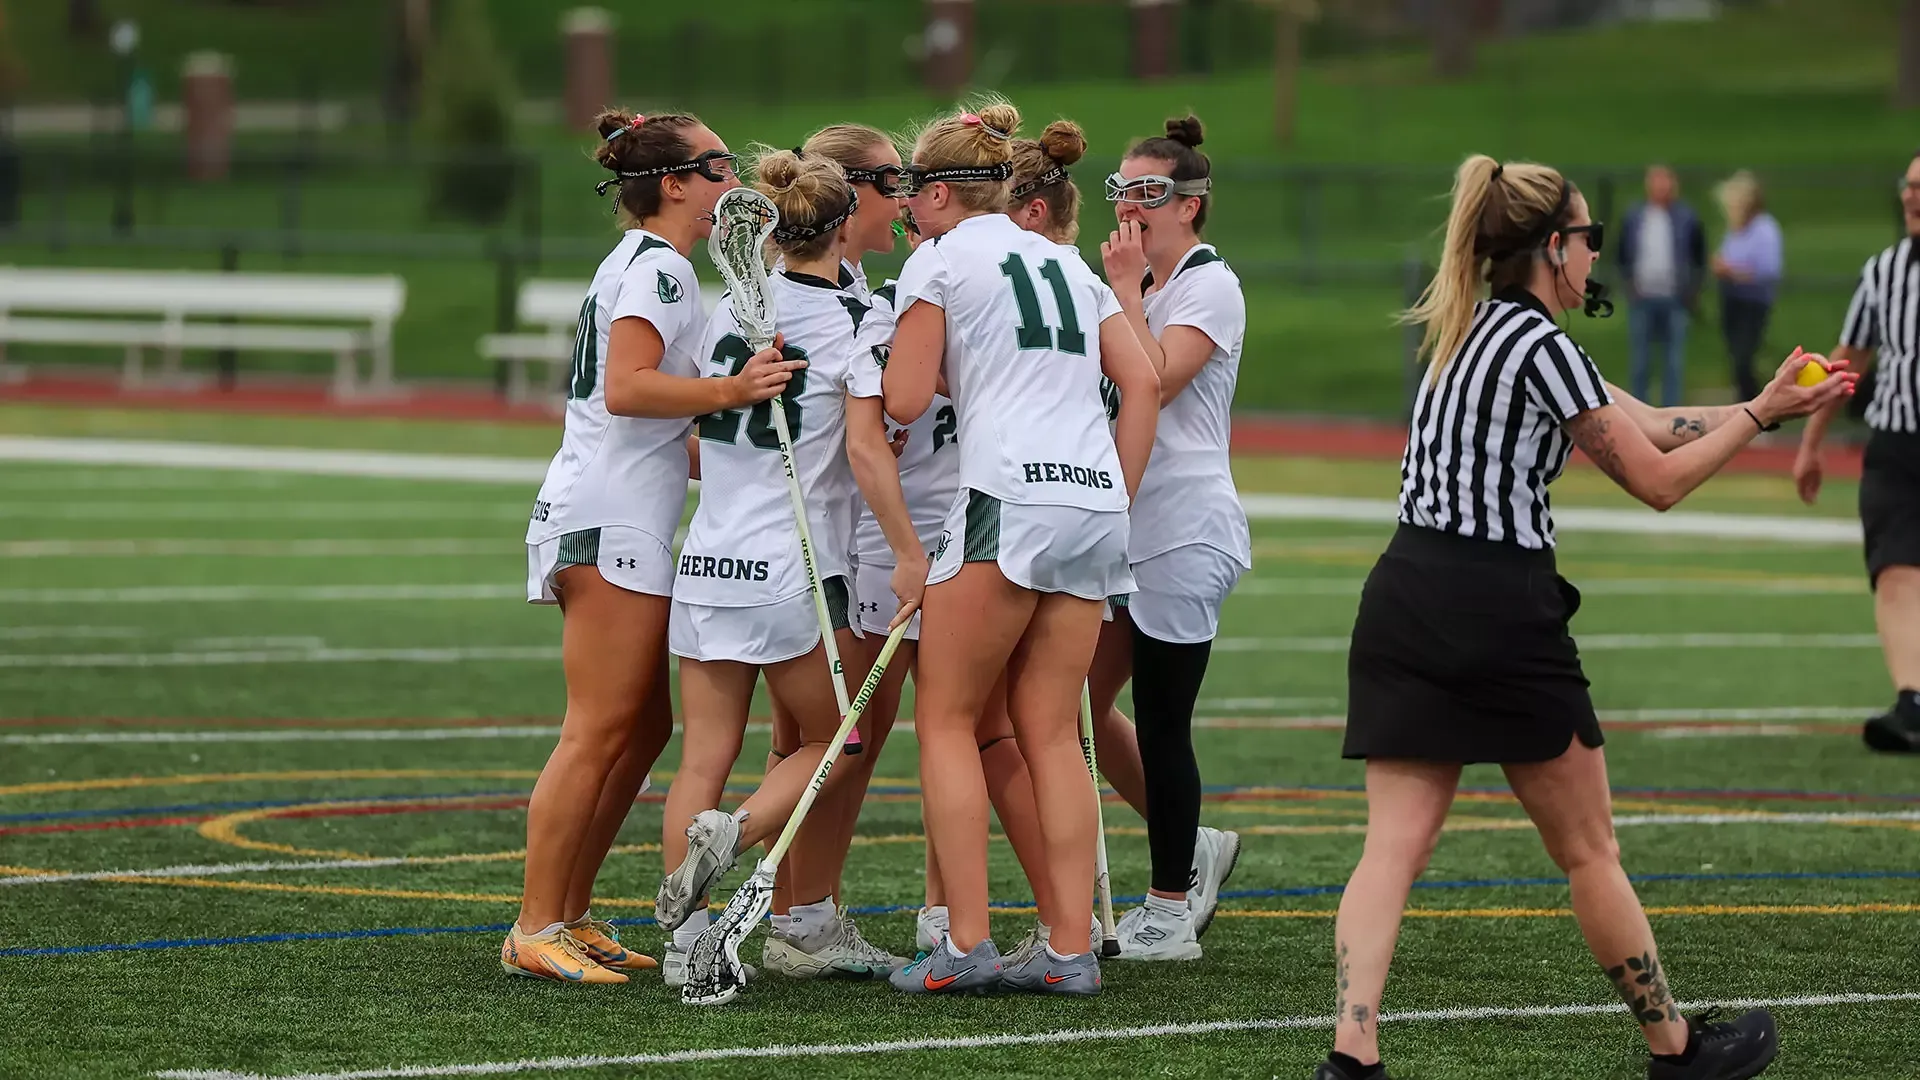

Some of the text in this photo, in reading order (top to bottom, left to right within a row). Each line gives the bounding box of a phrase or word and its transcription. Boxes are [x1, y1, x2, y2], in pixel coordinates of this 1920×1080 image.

[924, 168, 992, 179] ARMOUR
[823, 212, 846, 233] STX
[998, 251, 1087, 357] 11
[1022, 462, 1114, 490] HERONS
[679, 554, 769, 582] HERONS
[853, 663, 886, 714] HERONS
